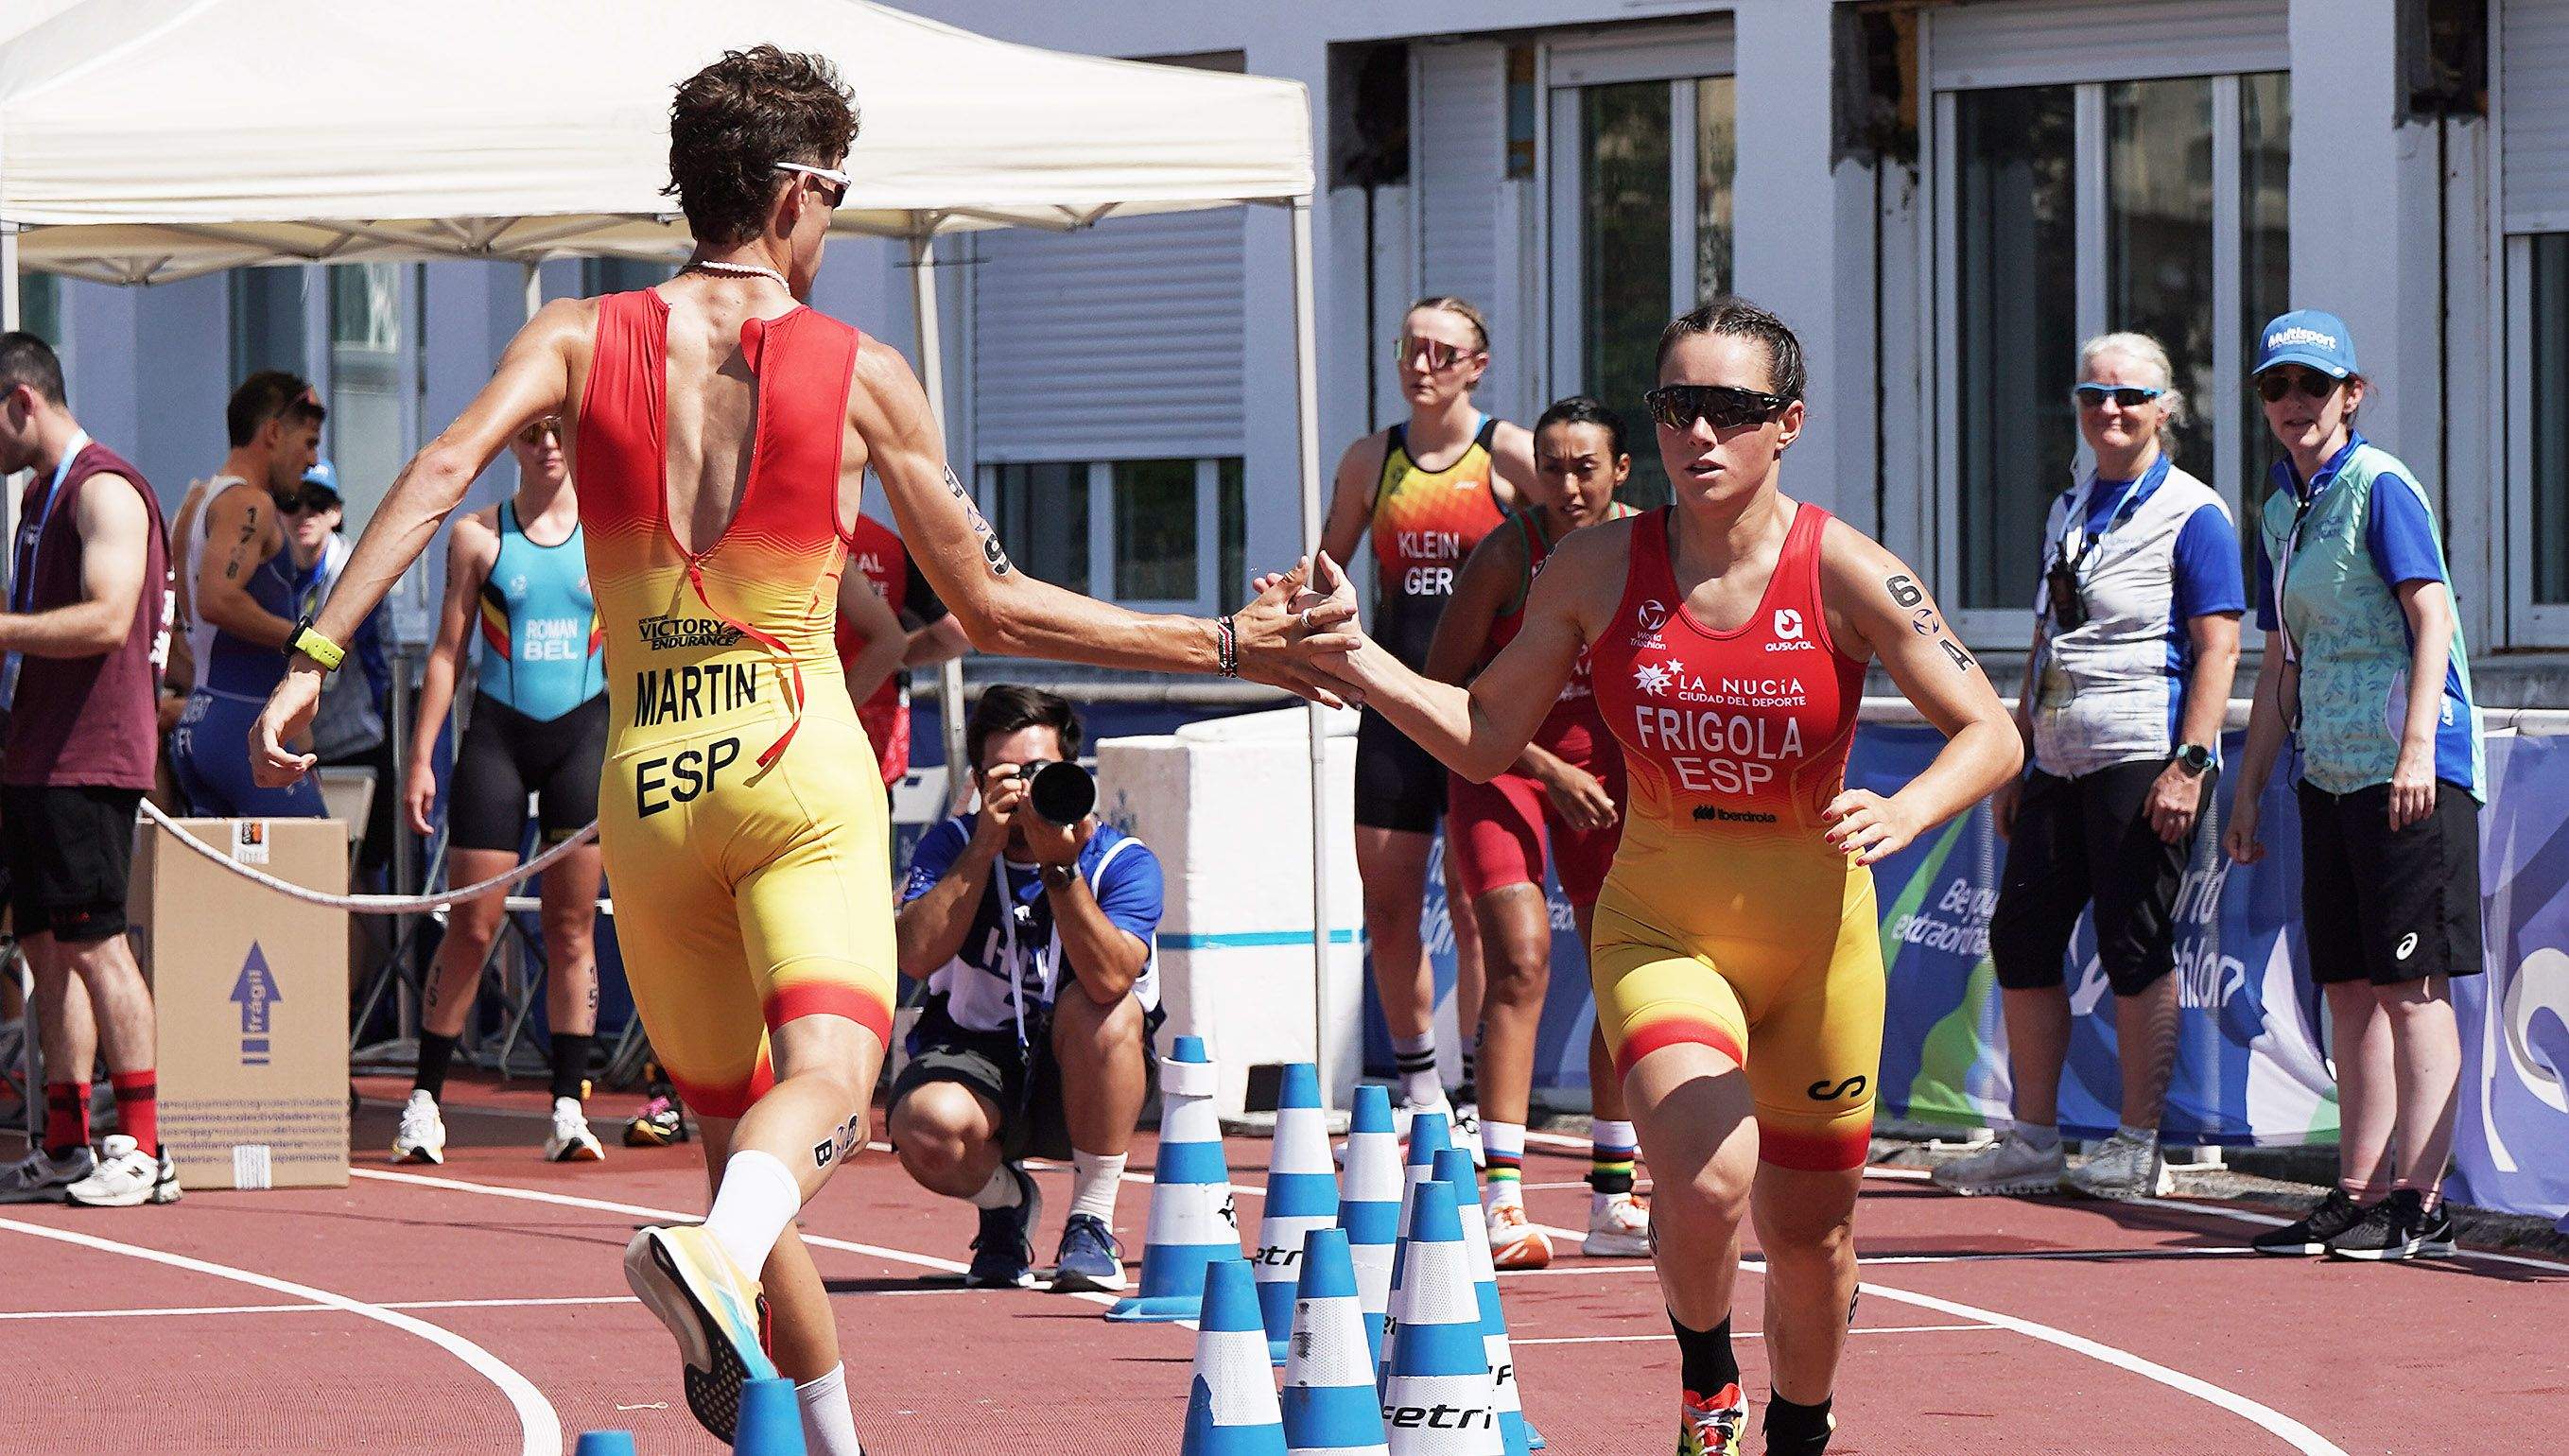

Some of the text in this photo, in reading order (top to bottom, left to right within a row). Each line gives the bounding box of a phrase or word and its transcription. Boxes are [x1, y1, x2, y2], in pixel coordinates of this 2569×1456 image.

[2267, 327, 2336, 350] Multisport
[1397, 530, 1459, 559] KLEIN
[1404, 566, 1453, 596] GER
[526, 617, 578, 640] ROMAN
[638, 618, 727, 639] VICTORY
[1886, 575, 1974, 671] 6 A
[523, 640, 580, 661] BEL
[651, 634, 736, 651] ENDURANCE
[634, 663, 756, 727] MARTIN
[1679, 675, 1707, 692] LA
[1678, 691, 1807, 708] CIUDAD DEL DEPORTE
[1636, 704, 1804, 760] FRIGOLA
[637, 737, 740, 819] ESP
[1672, 756, 1774, 796] ESP
[1938, 878, 2001, 925] Be you
[814, 1138, 833, 1168] B
